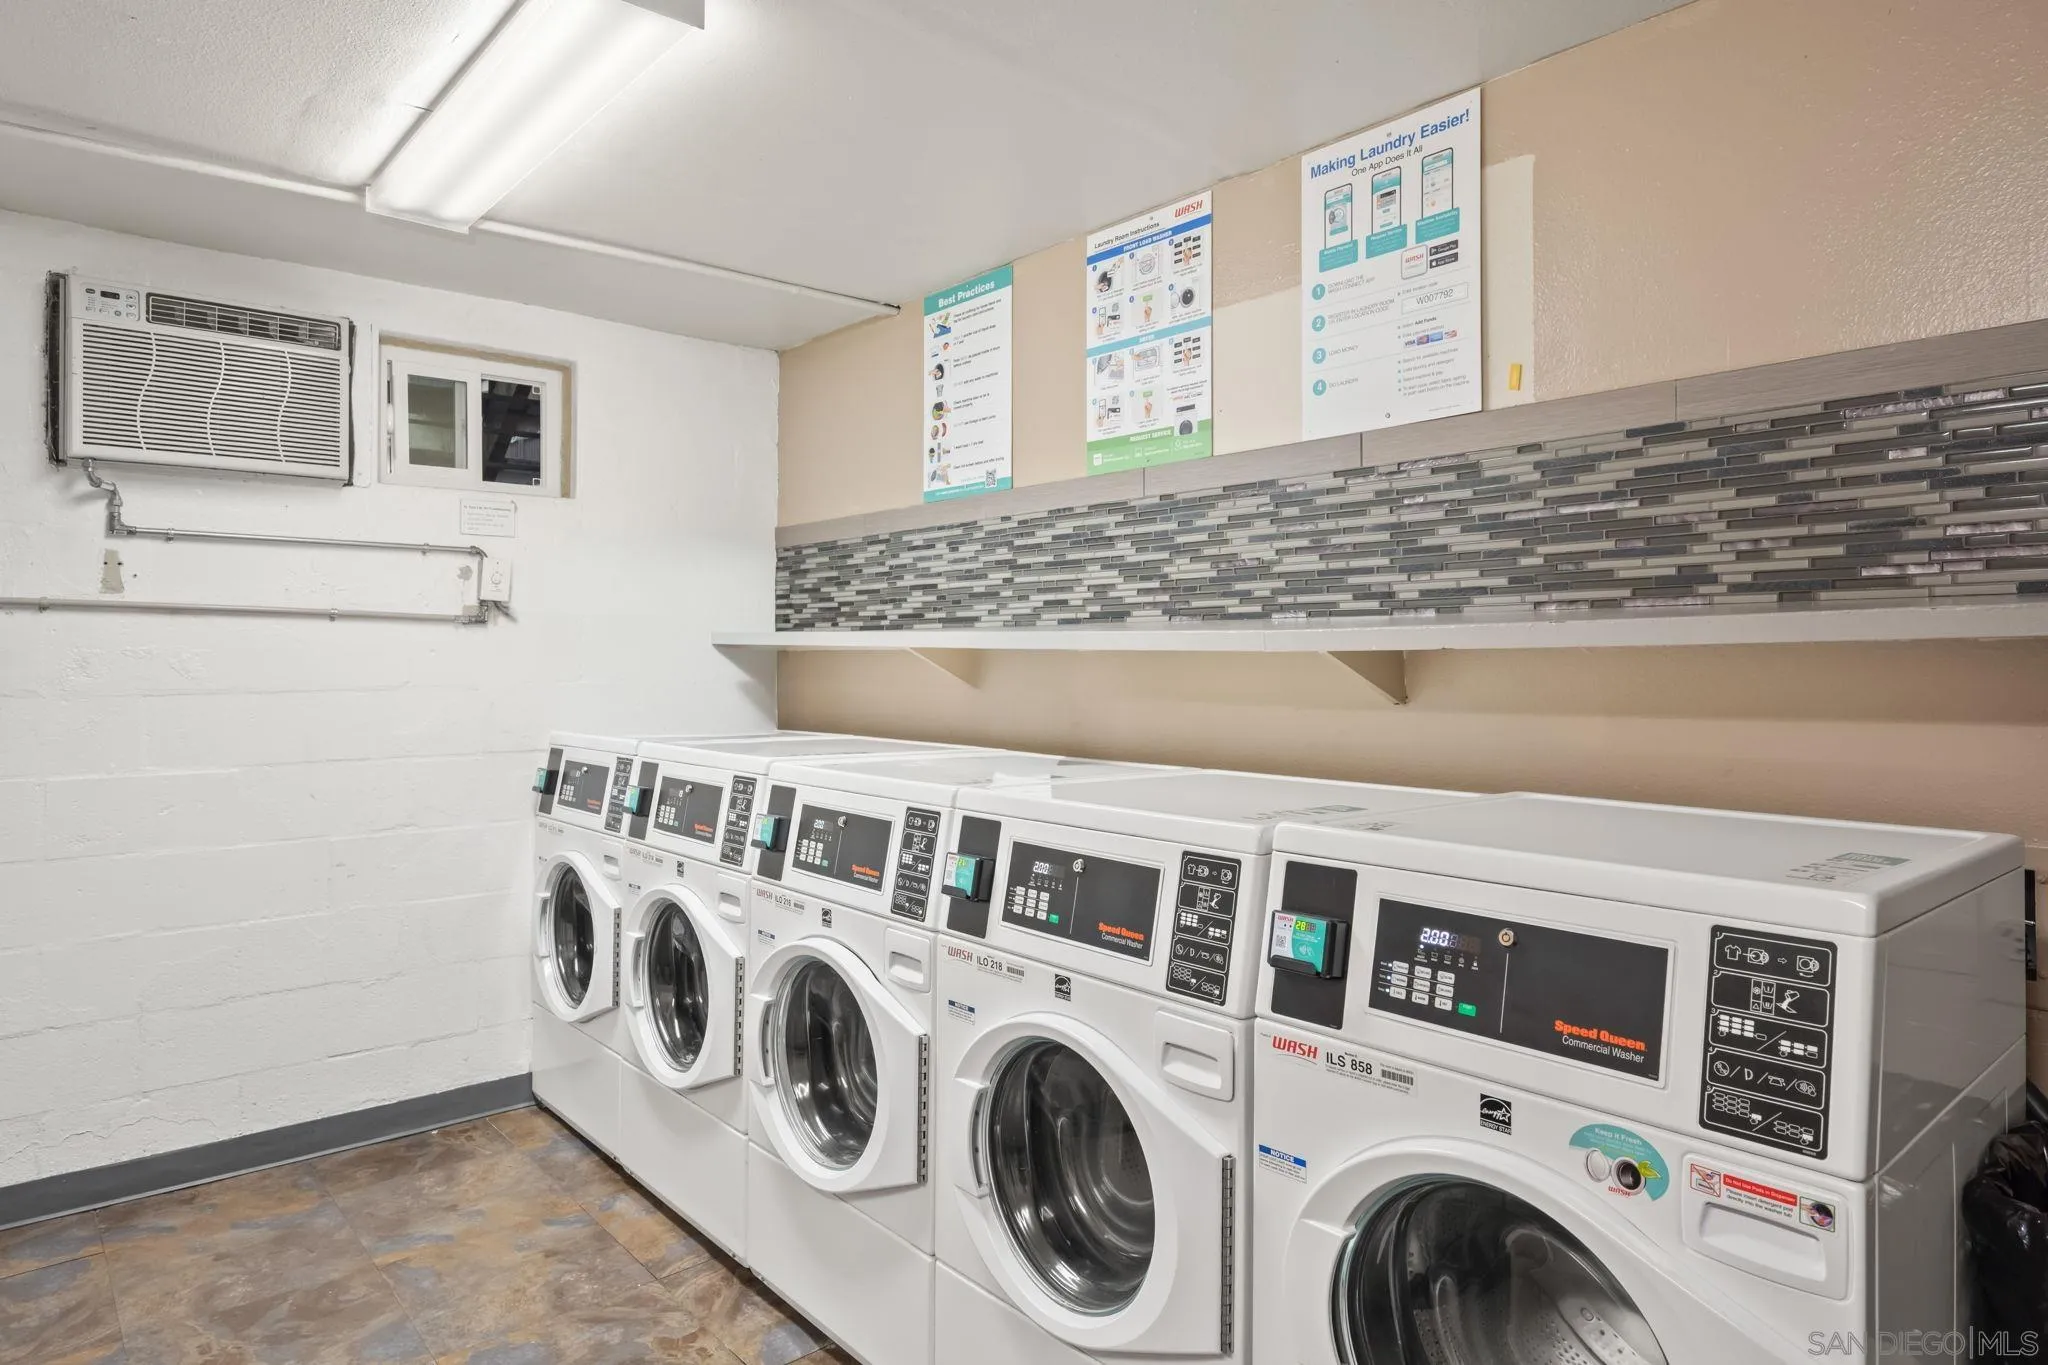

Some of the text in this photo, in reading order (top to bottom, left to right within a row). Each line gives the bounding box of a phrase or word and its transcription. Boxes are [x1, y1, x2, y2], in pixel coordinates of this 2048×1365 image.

[1310, 109, 1470, 179] Making Laundry Easier!
[1352, 145, 1423, 177] One App Does It All
[1174, 199, 1203, 218] WASH
[1094, 222, 1160, 249] Laundry Room Instructions
[938, 280, 995, 308] Best Practices
[1416, 289, 1454, 304] W007792
[756, 888, 773, 900] WASH
[1098, 922, 1144, 941] Speed Queen
[948, 946, 974, 962] WASH
[976, 956, 1003, 972] ILO 218
[1554, 1020, 1646, 1051] Speed Queen
[1272, 1035, 1318, 1060] WASH
[1562, 1034, 1645, 1064] Commercial Washer
[1326, 1052, 1373, 1075] ILS 858
[1480, 1120, 1498, 1130] ENERGY
[1595, 1128, 1613, 1138] Keep
[1622, 1134, 1642, 1145] Fresh
[1270, 1149, 1294, 1163] NOTICE
[1608, 1186, 1632, 1198] WASH
